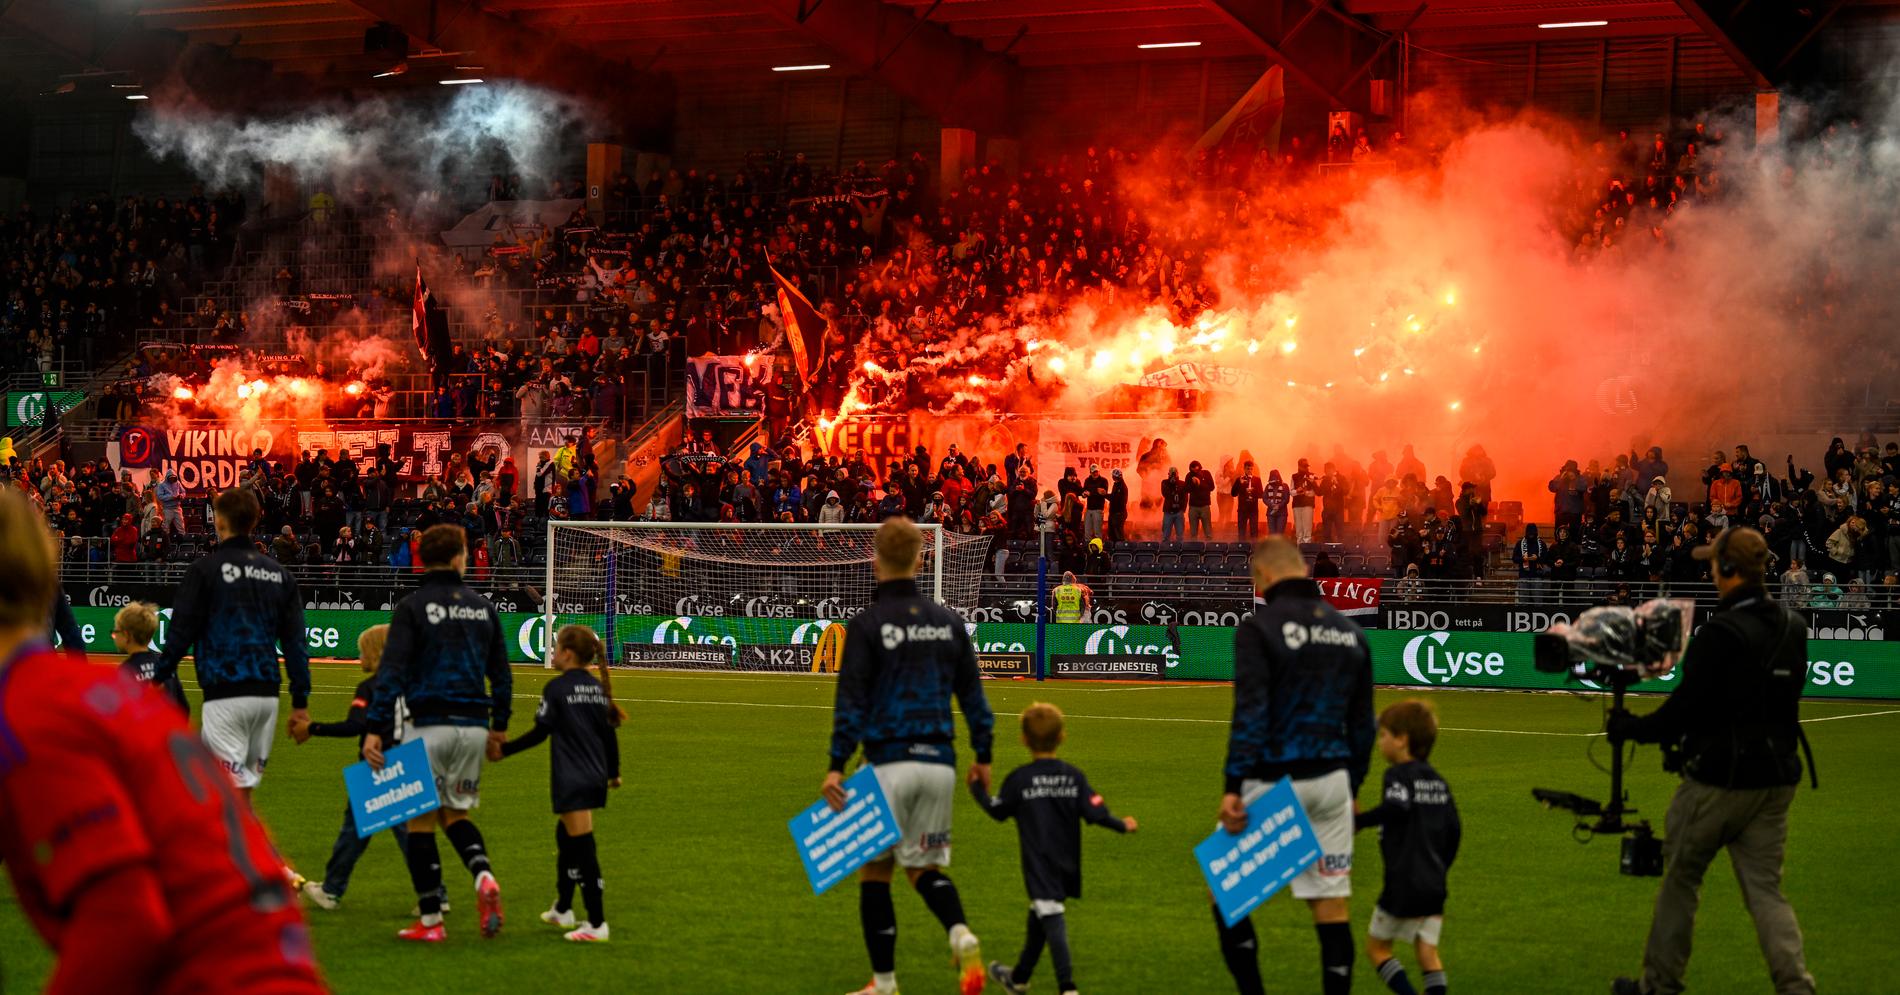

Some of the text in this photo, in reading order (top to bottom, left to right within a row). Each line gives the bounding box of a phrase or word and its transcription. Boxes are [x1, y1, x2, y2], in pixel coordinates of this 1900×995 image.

[166, 429, 248, 458] VIKING
[244, 565, 283, 584] Kabal
[99, 592, 131, 607] Lyse
[1315, 580, 1378, 605] KING
[494, 598, 517, 613] yse
[448, 606, 490, 622] Kabal
[1455, 618, 1468, 627] tett
[1470, 617, 1483, 630] på
[906, 624, 953, 641] Kabal
[1310, 625, 1358, 647] Kabal
[629, 651, 726, 662] TS BYGGTJENESTER
[770, 649, 795, 665] K2
[1427, 645, 1505, 683] Lyse
[978, 660, 1022, 670] ØRVEST
[1057, 661, 1158, 673] TS BYGGTJENESTER
[371, 760, 405, 786] Start
[364, 779, 425, 814] samtalen
